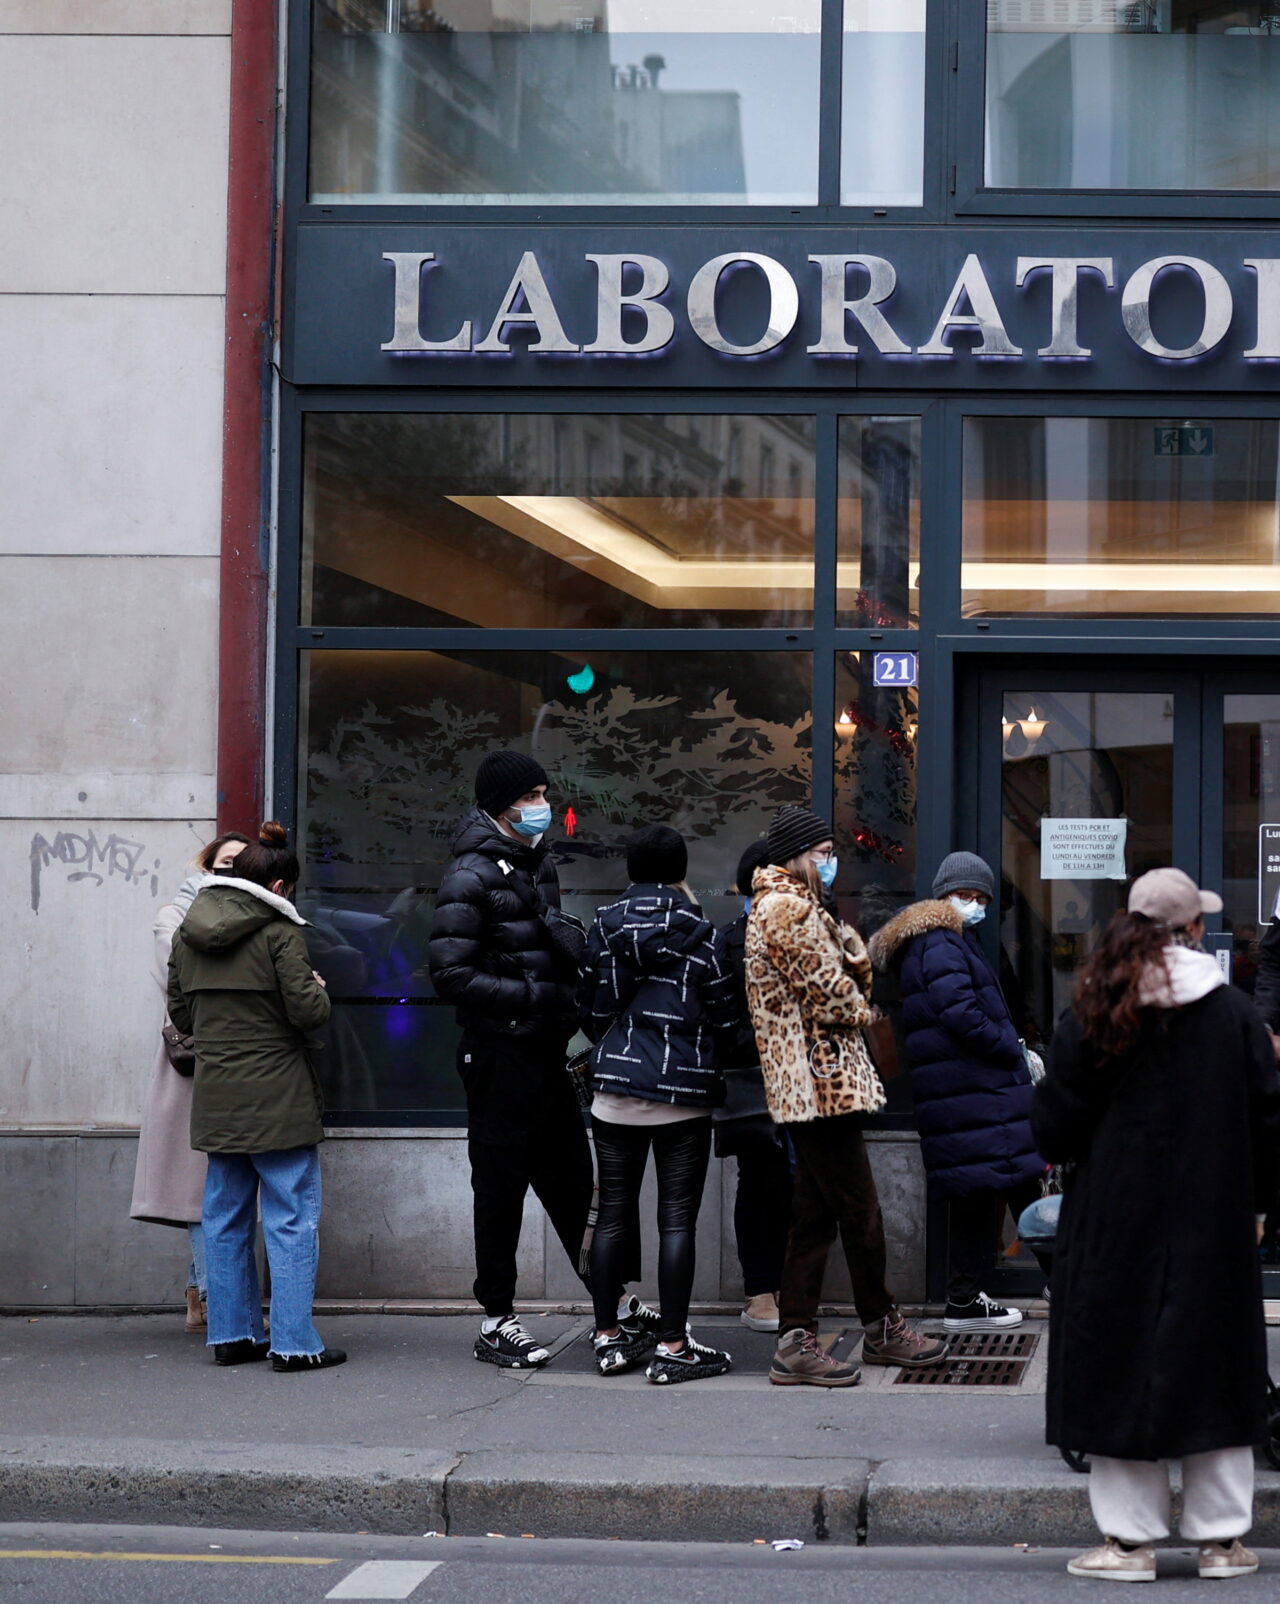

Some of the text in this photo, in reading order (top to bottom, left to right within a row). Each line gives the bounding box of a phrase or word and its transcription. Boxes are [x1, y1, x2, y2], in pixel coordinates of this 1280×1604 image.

[880, 657, 911, 680] 21
[1098, 833, 1119, 841] COVID
[1063, 862, 1071, 870] DE
